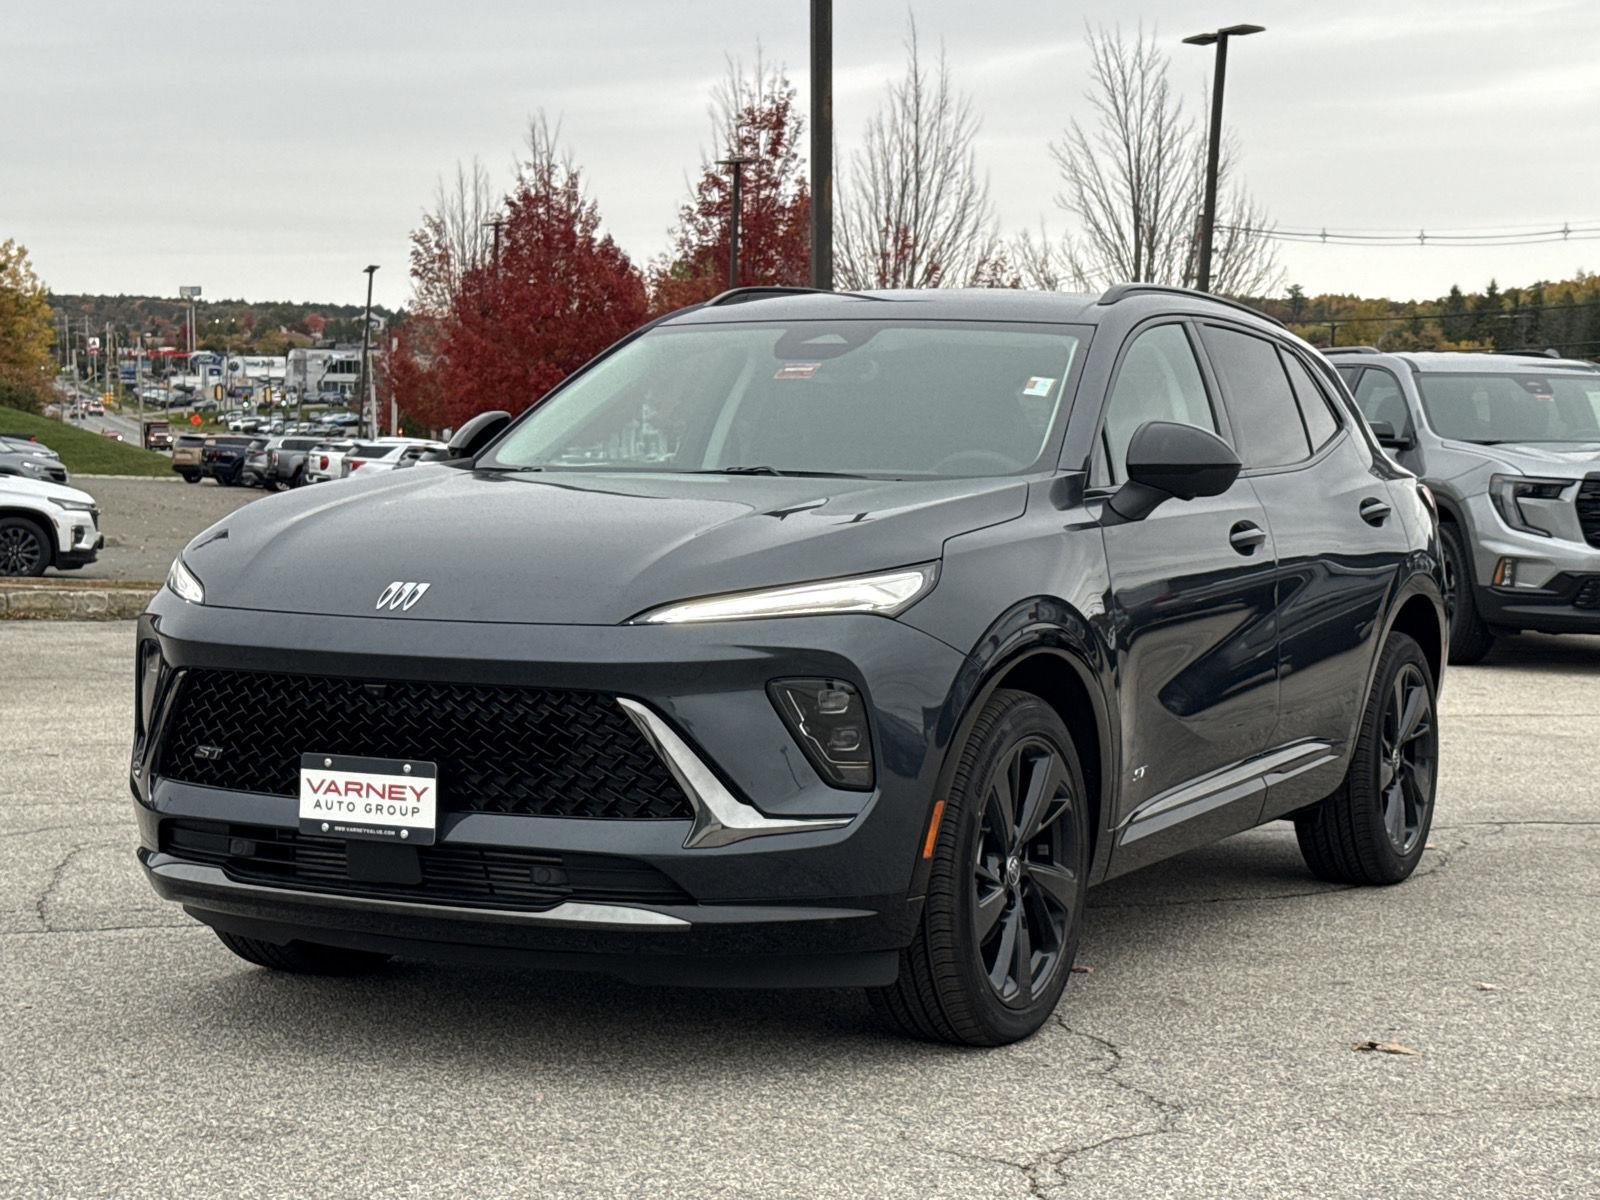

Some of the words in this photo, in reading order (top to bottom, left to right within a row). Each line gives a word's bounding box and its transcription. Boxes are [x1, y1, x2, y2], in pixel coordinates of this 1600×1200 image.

[306, 777, 430, 803] VARNEY
[313, 799, 356, 812] AUTO
[364, 803, 420, 817] GROUP
